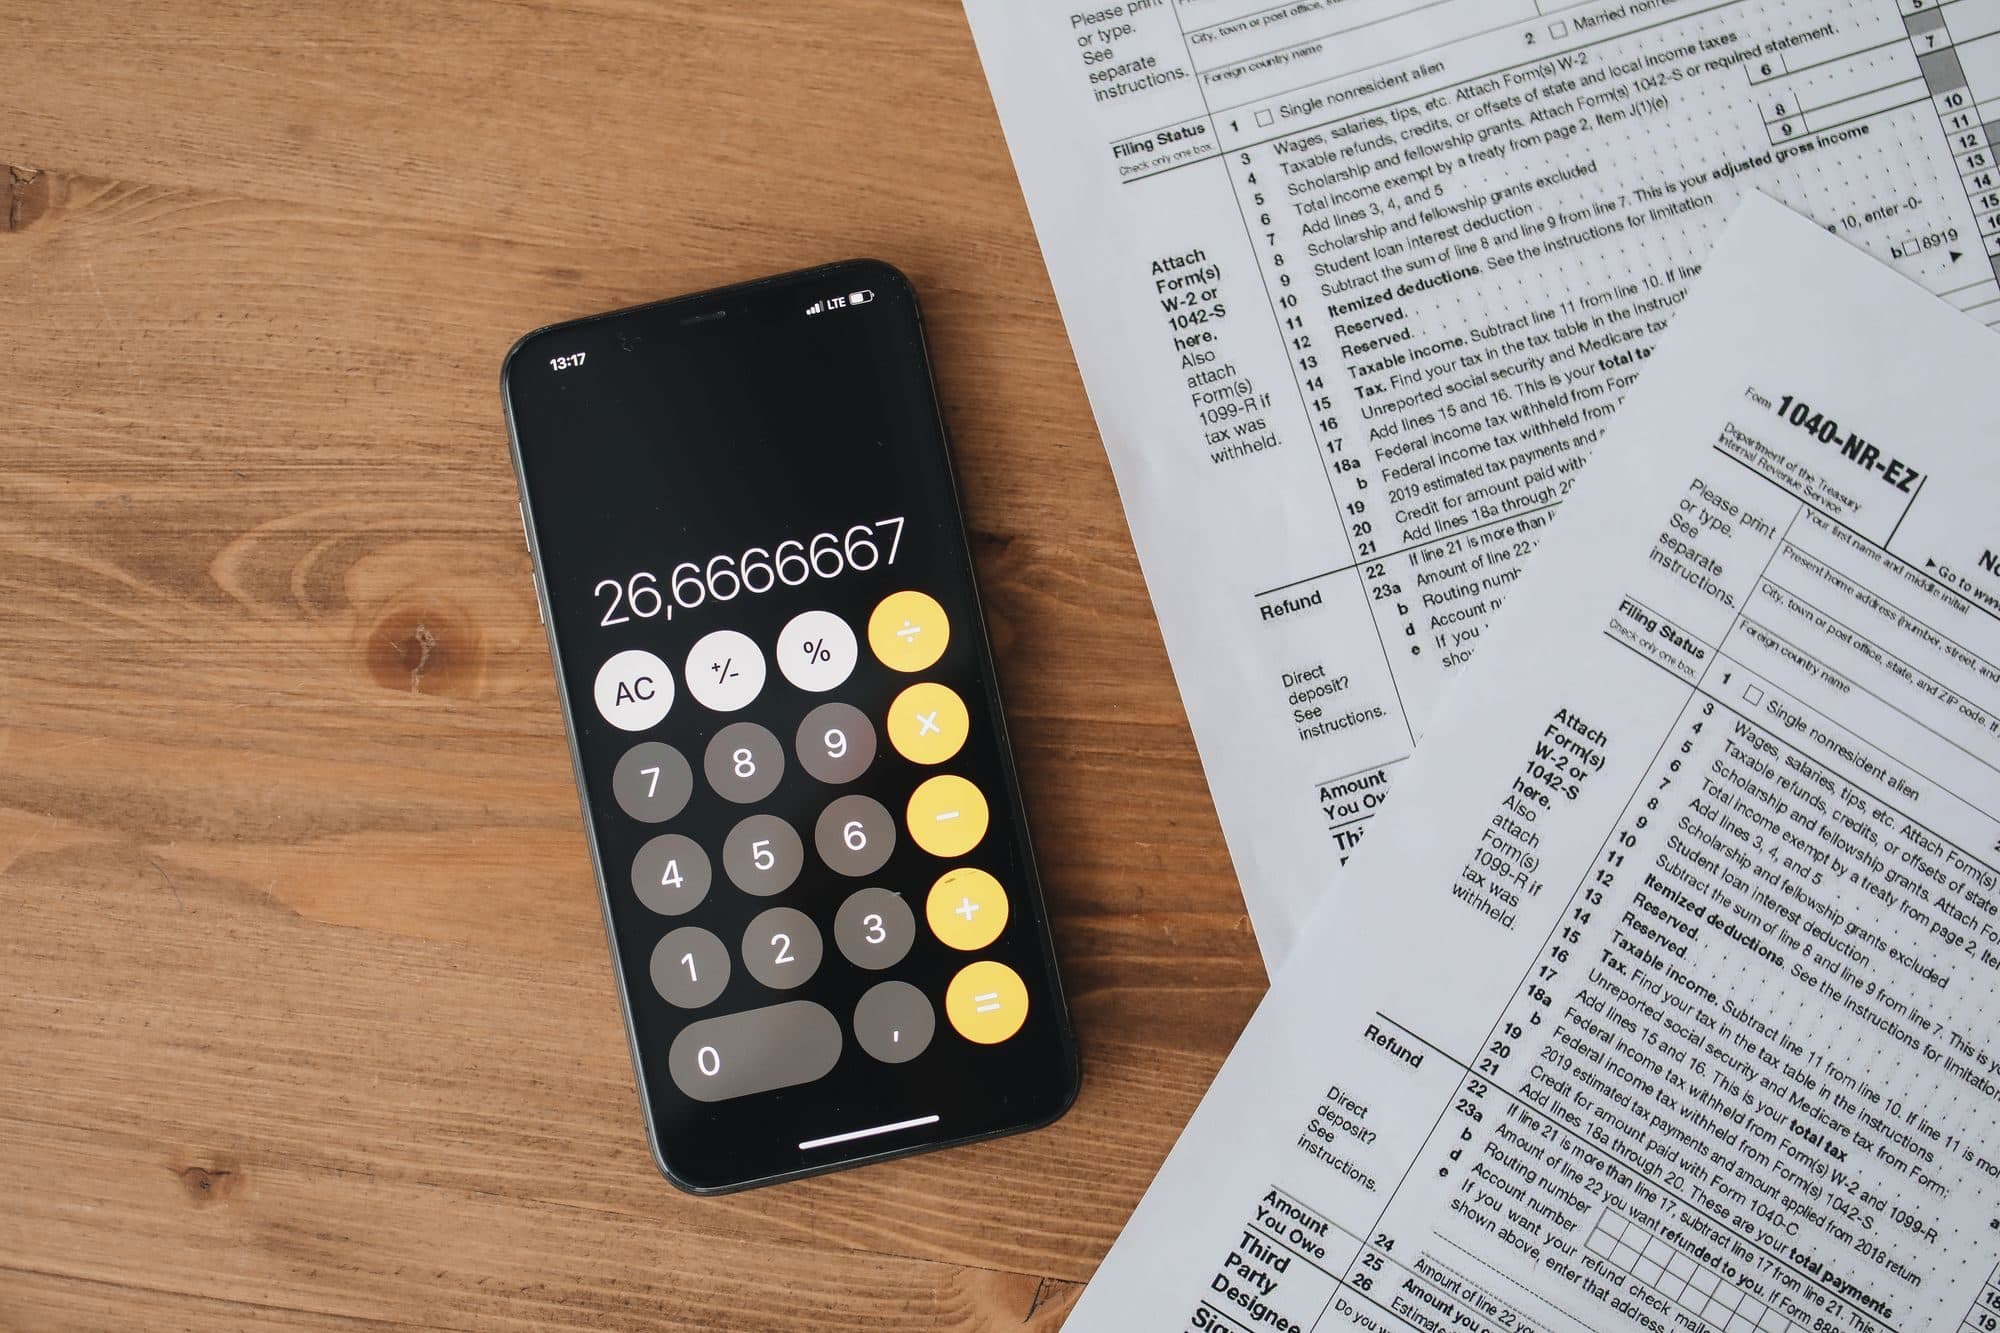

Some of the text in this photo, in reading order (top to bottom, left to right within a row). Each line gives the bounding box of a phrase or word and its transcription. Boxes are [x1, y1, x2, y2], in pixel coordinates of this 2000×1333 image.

[1069, 6, 1123, 29] Please
[1077, 23, 1136, 47] or type.
[1082, 48, 1113, 65] See
[1088, 56, 1156, 84] separate
[1093, 67, 1190, 102] instructions.
[1229, 61, 1445, 132] 1 Single nonresident alien
[1240, 51, 1588, 165] 3 Wages, salaries, tips, etc. Attach Form(s) W-2
[1112, 124, 1206, 159] Filing Status
[1958, 133, 1978, 149] 12
[1966, 153, 1985, 168] 13
[1973, 172, 1992, 189] 14
[1265, 183, 1444, 246] 7 Add lines 3, 4, and 5
[1921, 227, 1958, 249] 8919
[1151, 248, 1206, 276] Attach
[1155, 263, 1221, 294] Form(s)
[1285, 194, 1713, 330] 11 Itemized deductions. See the instructions for limitation
[827, 297, 846, 310] LTE
[1159, 287, 1217, 313] W-2 or
[1167, 303, 1226, 331] 1042-S
[1173, 331, 1218, 352] here.
[550, 352, 585, 371] 13:17
[1744, 386, 1920, 494] Form 1040-NR-EZ
[1717, 432, 1845, 514] Internal Revenue Service
[1722, 421, 1862, 513] Department of the Treasury
[595, 517, 905, 627] 26,6666667
[1259, 589, 1323, 621] Refund
[1617, 599, 1704, 659] Filing Status
[804, 639, 830, 664] %
[1738, 619, 1850, 693] Foreign country name
[616, 677, 654, 706] AC
[1281, 664, 1326, 688] Direct
[1288, 675, 1349, 706] deposit?
[1293, 706, 1322, 723] See
[1297, 706, 1387, 741] instructions.
[824, 729, 847, 758] 9
[1721, 672, 1919, 801] 1 Single nonresident alien
[733, 749, 755, 777] 8
[641, 767, 659, 797] 7
[1319, 769, 1388, 803] Amount
[1501, 794, 1536, 822] Also
[844, 821, 866, 850] 6
[1491, 814, 1539, 849] attach
[752, 840, 774, 870] 5
[1481, 827, 1539, 874] Form(s)
[662, 860, 683, 888] 4
[1461, 863, 1519, 908] tax was
[1473, 847, 1543, 897] 1099-R if
[1451, 882, 1516, 931] withheld.
[1646, 796, 1950, 990] 8 Scholarship and fellowship grants excluded
[864, 914, 886, 943] 3
[771, 934, 794, 964] 2
[681, 953, 697, 981] 1
[1363, 1023, 1424, 1069] Refund
[1561, 925, 1934, 1163] 15 Tax. Find your tax in the tax table in the instructions
[698, 1047, 720, 1076] 0
[1325, 1085, 1368, 1119] Direct
[1527, 983, 1938, 1244] 18a Federal income tax withheld from Form(s) W-2 and 1099-R
[1306, 1118, 1334, 1143] See
[1316, 1103, 1376, 1145] deposit?
[1488, 1040, 1799, 1236] 20 Credit for amount paid with Form 1040-C
[1296, 1132, 1376, 1192] instructions.
[1459, 1126, 1592, 1214] b Routing number
[1448, 1148, 1578, 1232] d Account number
[1261, 1190, 1332, 1238] Amount
[1255, 1204, 1325, 1259] You Owe
[1239, 1230, 1291, 1274] Third
[1223, 1250, 1278, 1296] Party
[1210, 1272, 1301, 1333] Designee
